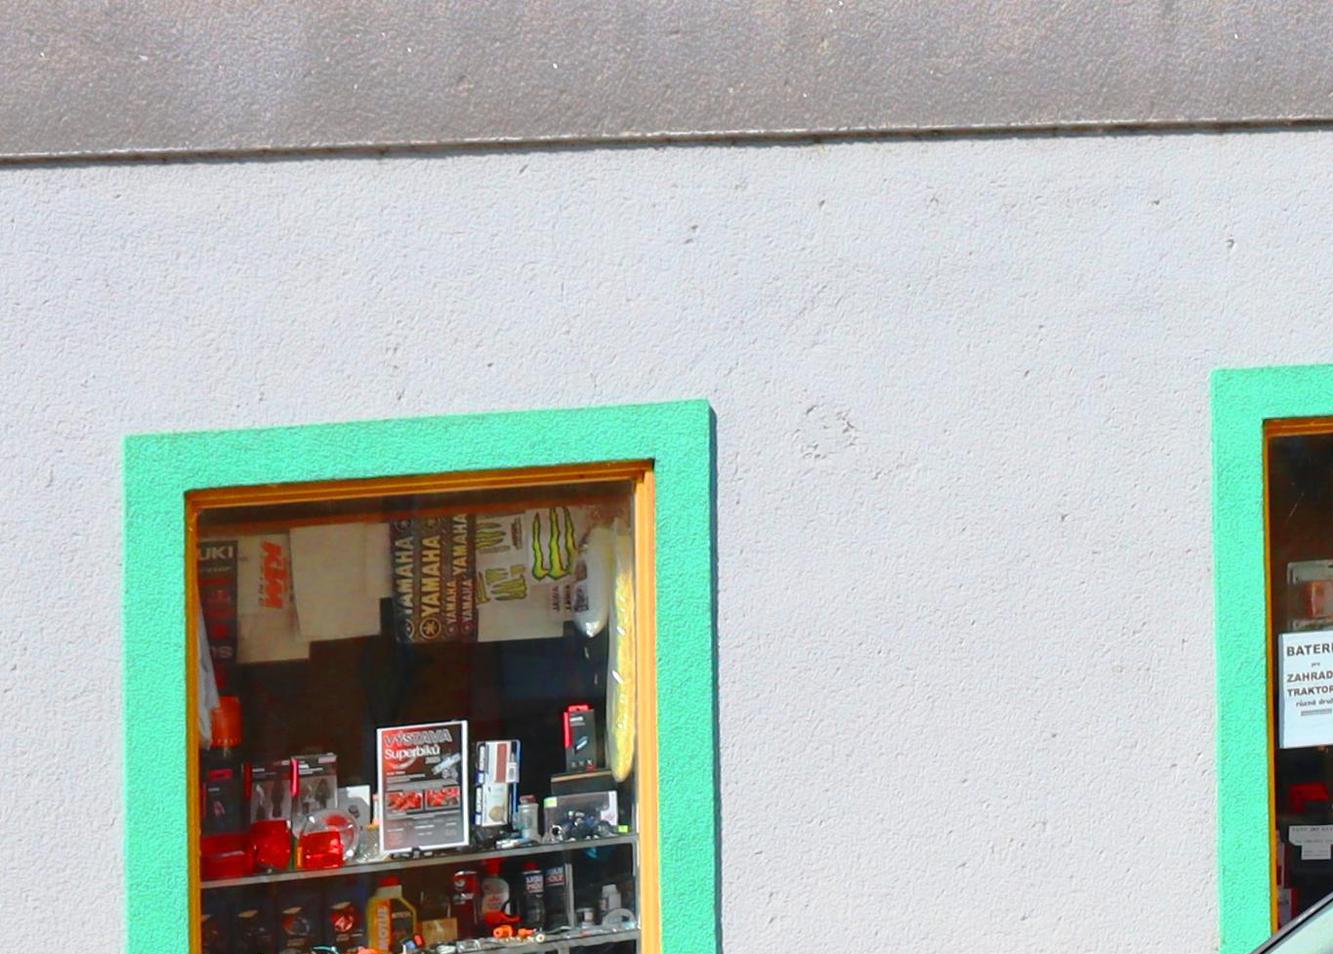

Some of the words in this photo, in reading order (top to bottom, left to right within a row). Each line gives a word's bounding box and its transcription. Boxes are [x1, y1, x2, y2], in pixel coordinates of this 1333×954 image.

[452, 513, 467, 576] YAMAHA
[421, 535, 440, 618] YAMAHA
[384, 744, 441, 760] Superbiků
